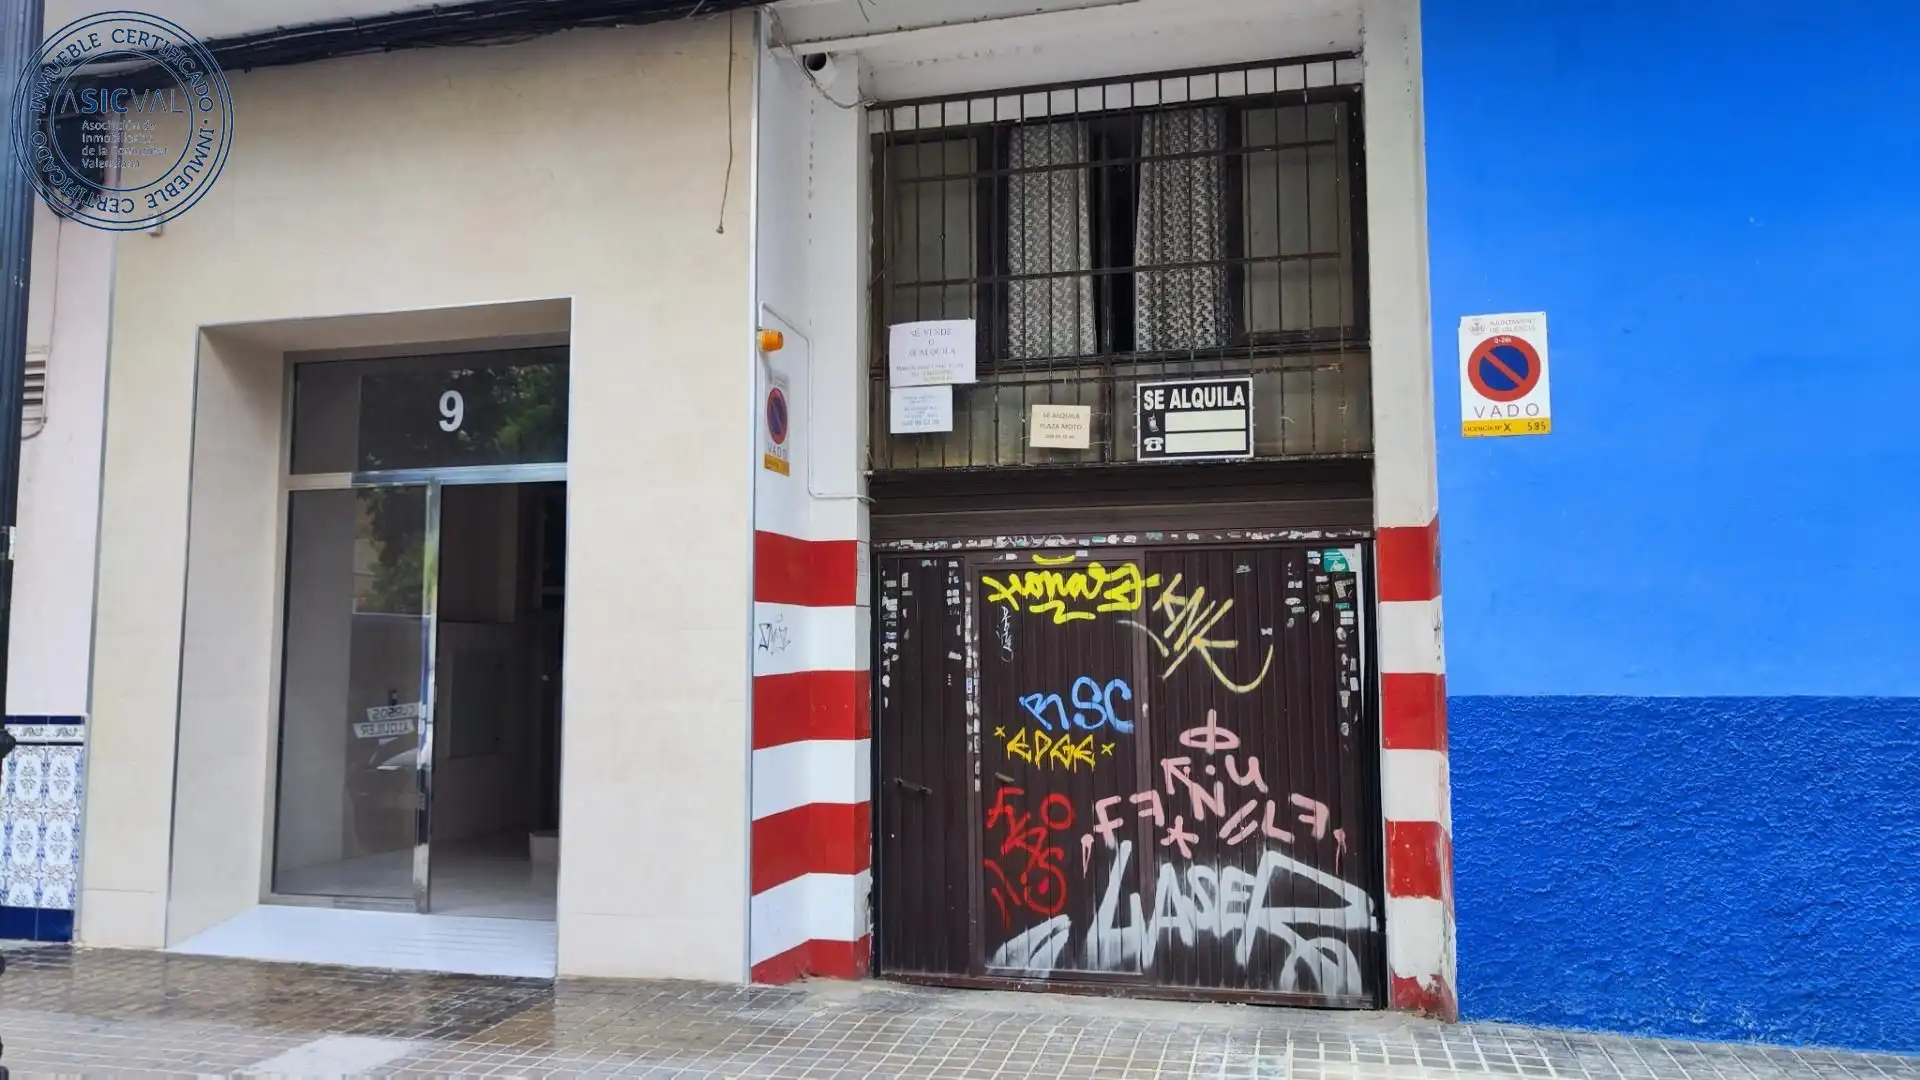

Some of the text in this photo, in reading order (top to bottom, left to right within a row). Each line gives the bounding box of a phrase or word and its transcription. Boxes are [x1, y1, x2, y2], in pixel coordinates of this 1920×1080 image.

[923, 328, 953, 337] VENDE
[1143, 386, 1245, 411] SE ALQUILA
[439, 390, 464, 432] 9
[1474, 403, 1539, 418] VADO
[1503, 423, 1512, 431] X
